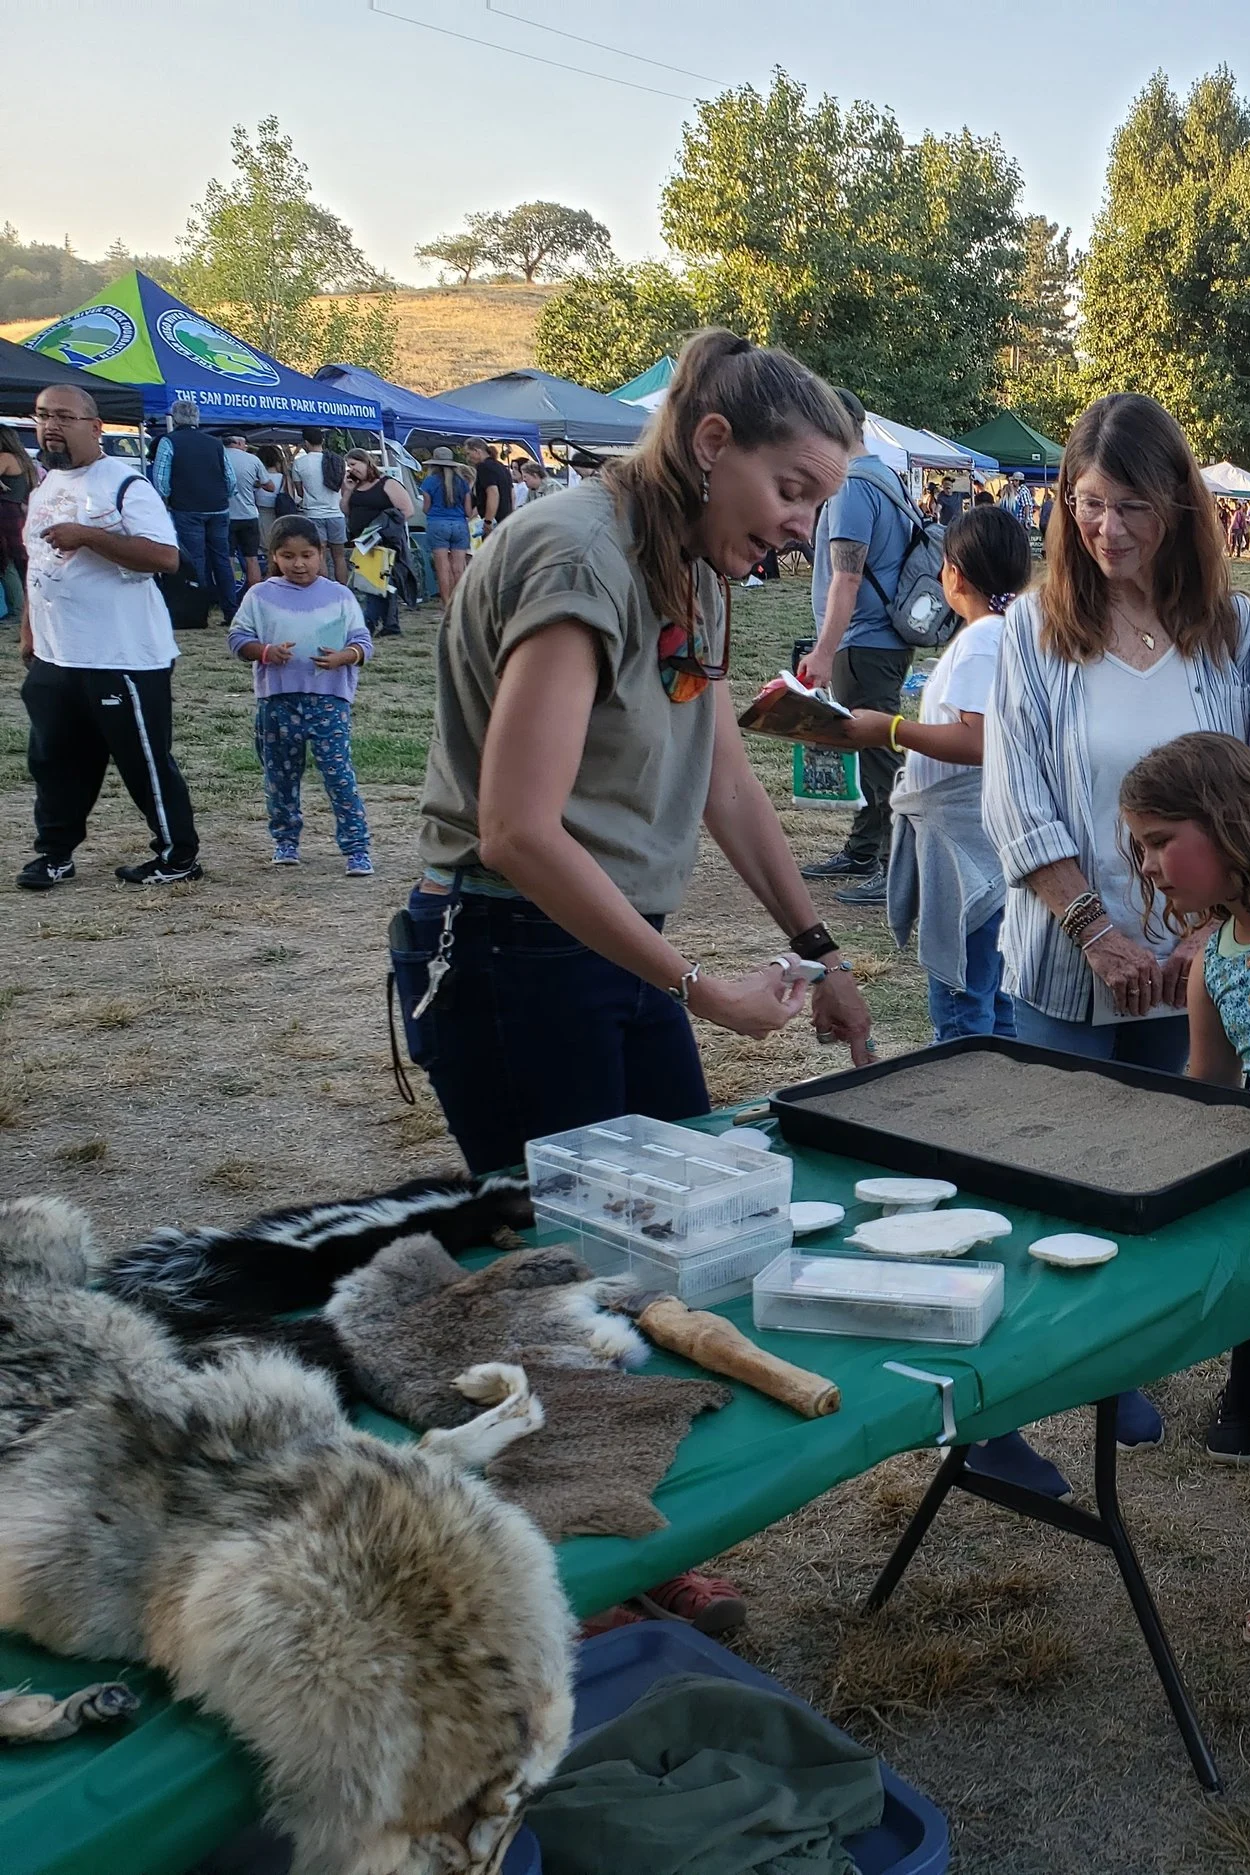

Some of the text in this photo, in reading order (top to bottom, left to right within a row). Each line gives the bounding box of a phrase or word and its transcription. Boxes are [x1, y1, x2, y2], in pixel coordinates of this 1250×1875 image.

[73, 307, 104, 319] RIVER
[103, 307, 126, 325] PARK
[99, 321, 133, 359] FOUNDATION
[175, 389, 376, 419] THE SAN DIEGO RIVER PARK FOUNDATION
